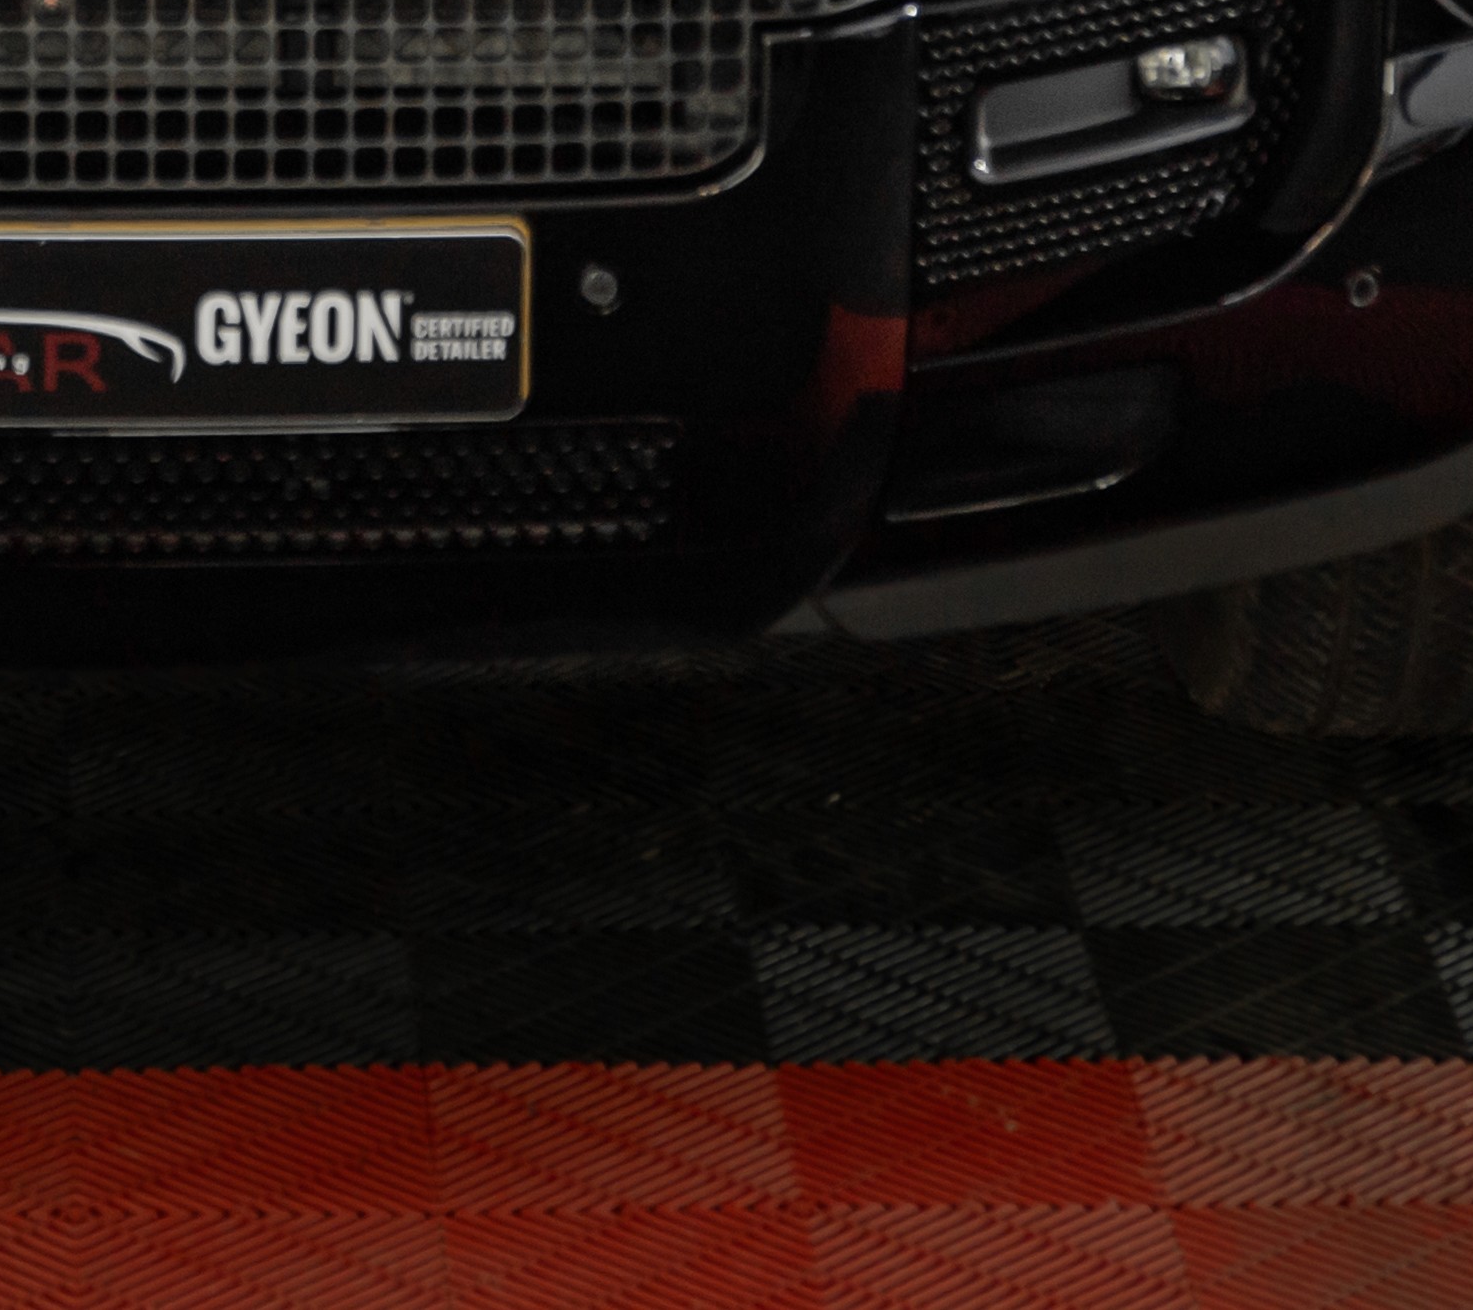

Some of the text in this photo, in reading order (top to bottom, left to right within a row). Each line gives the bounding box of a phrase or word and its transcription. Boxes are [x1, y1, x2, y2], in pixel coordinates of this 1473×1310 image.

[194, 289, 403, 365] GYEON
[411, 311, 516, 339] CERTIFIED
[411, 338, 507, 362] DETAILER
